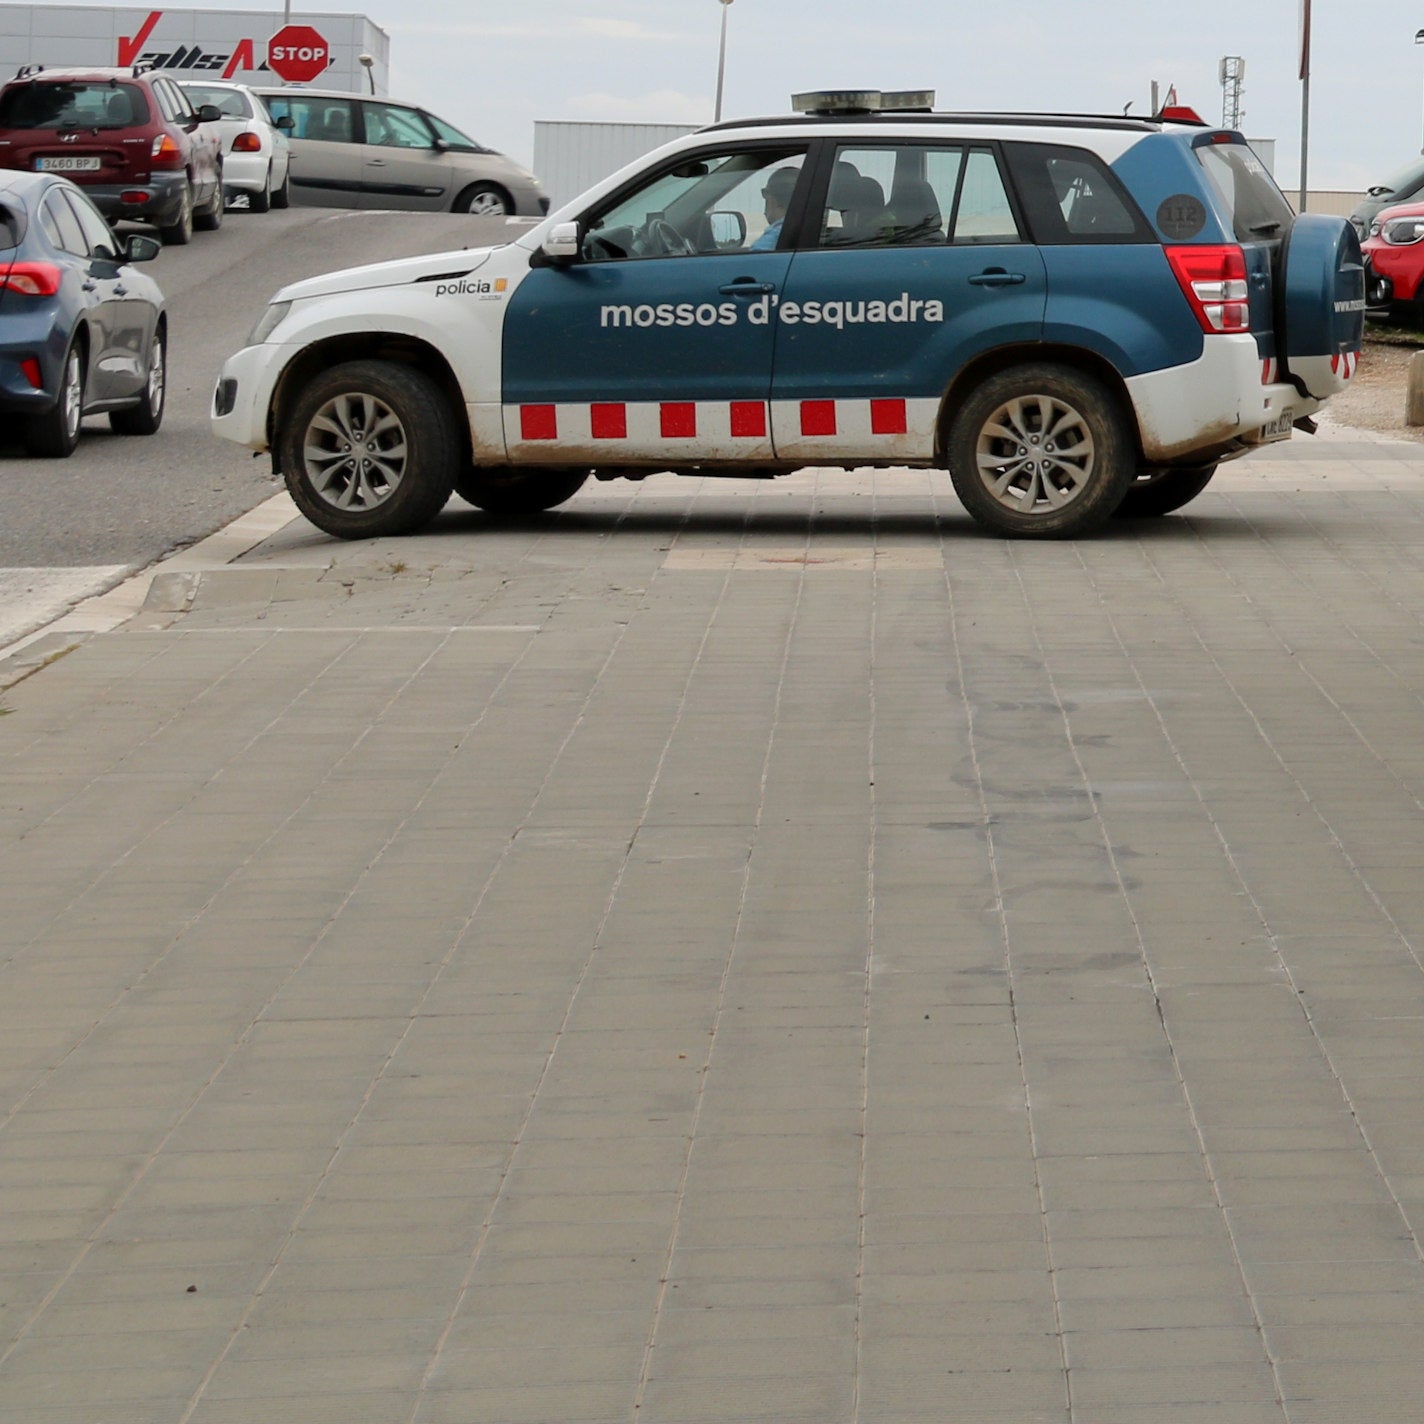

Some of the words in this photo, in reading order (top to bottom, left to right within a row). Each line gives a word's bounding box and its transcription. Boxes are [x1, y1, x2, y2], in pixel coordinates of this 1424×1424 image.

[271, 45, 325, 62] STOP
[44, 158, 73, 169] 3460
[435, 278, 491, 297] policia
[600, 302, 738, 327] mossos
[747, 292, 944, 329] d'esquadra
